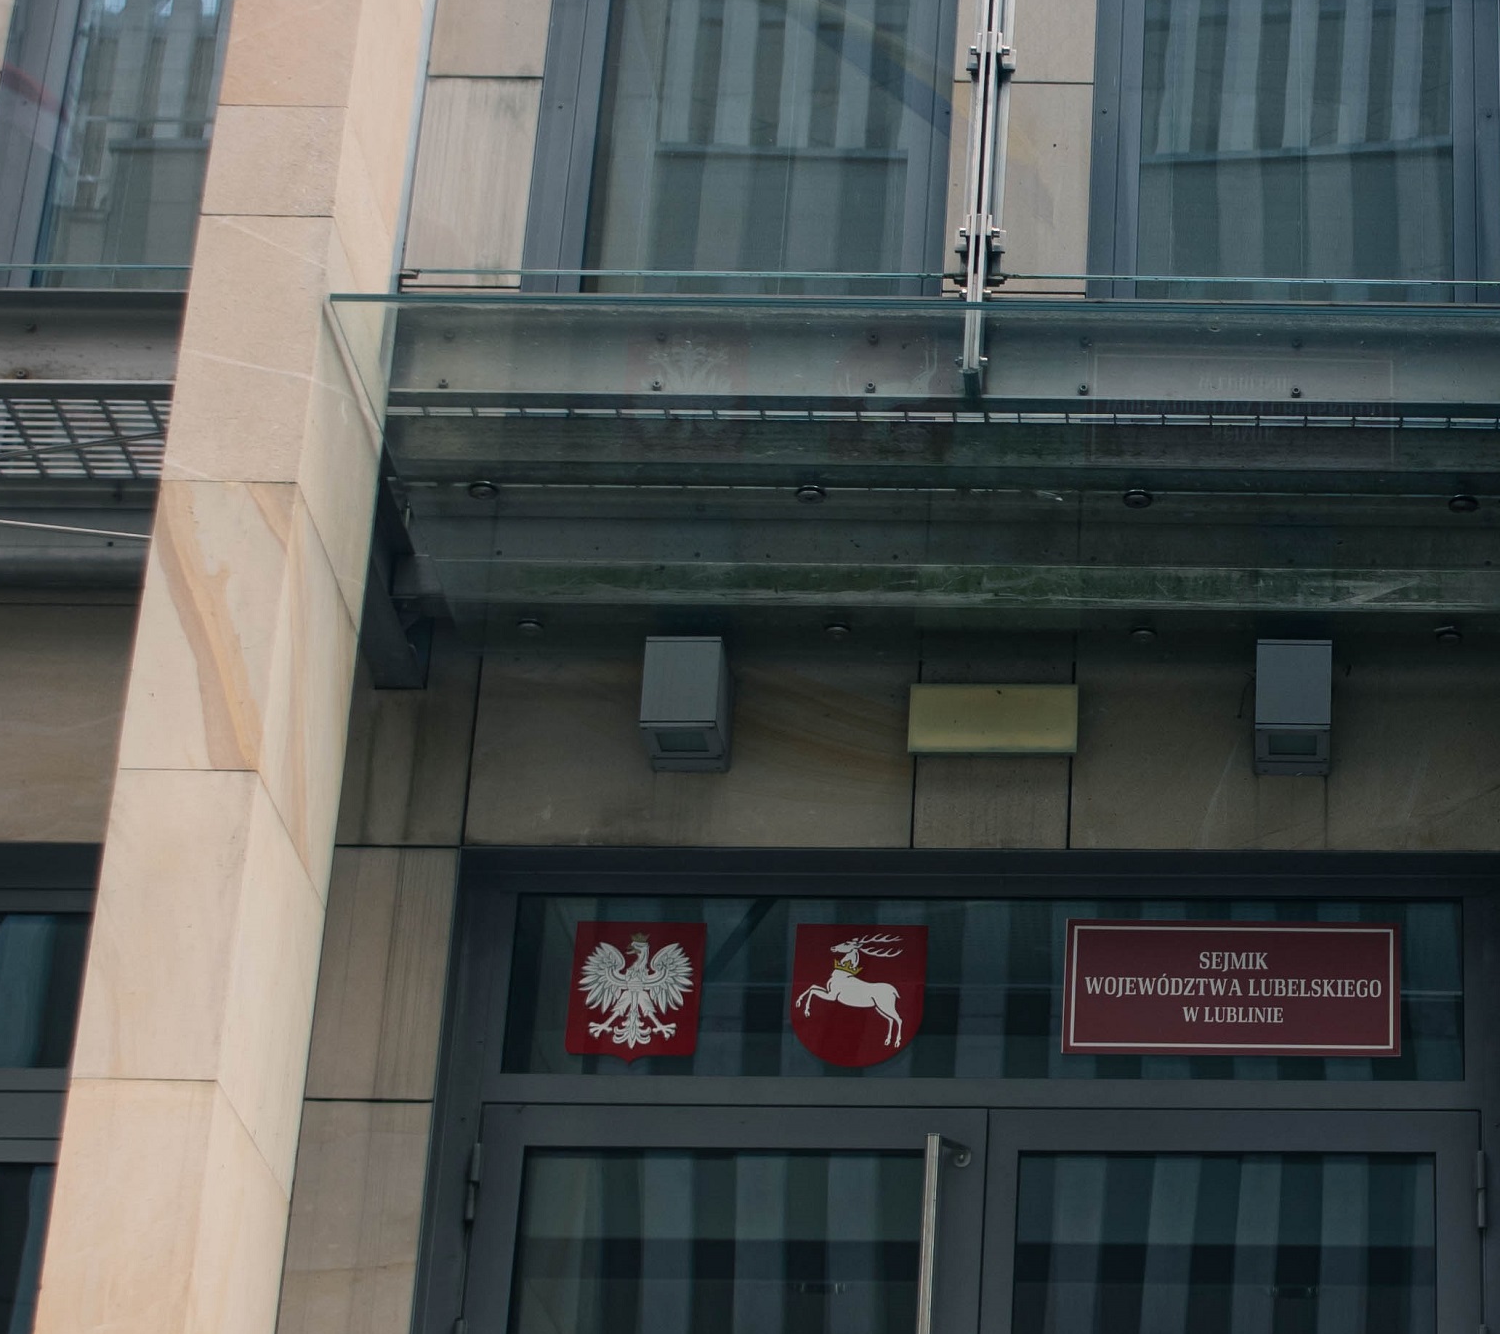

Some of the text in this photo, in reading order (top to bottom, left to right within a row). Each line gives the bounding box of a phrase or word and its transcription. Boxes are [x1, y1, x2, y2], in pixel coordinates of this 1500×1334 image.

[1199, 951, 1268, 972] SEJMIK
[1084, 973, 1382, 998] WOJEWÓDZTWA LUBELSKIEGO
[1182, 1006, 1284, 1023] W LUBLINIE
